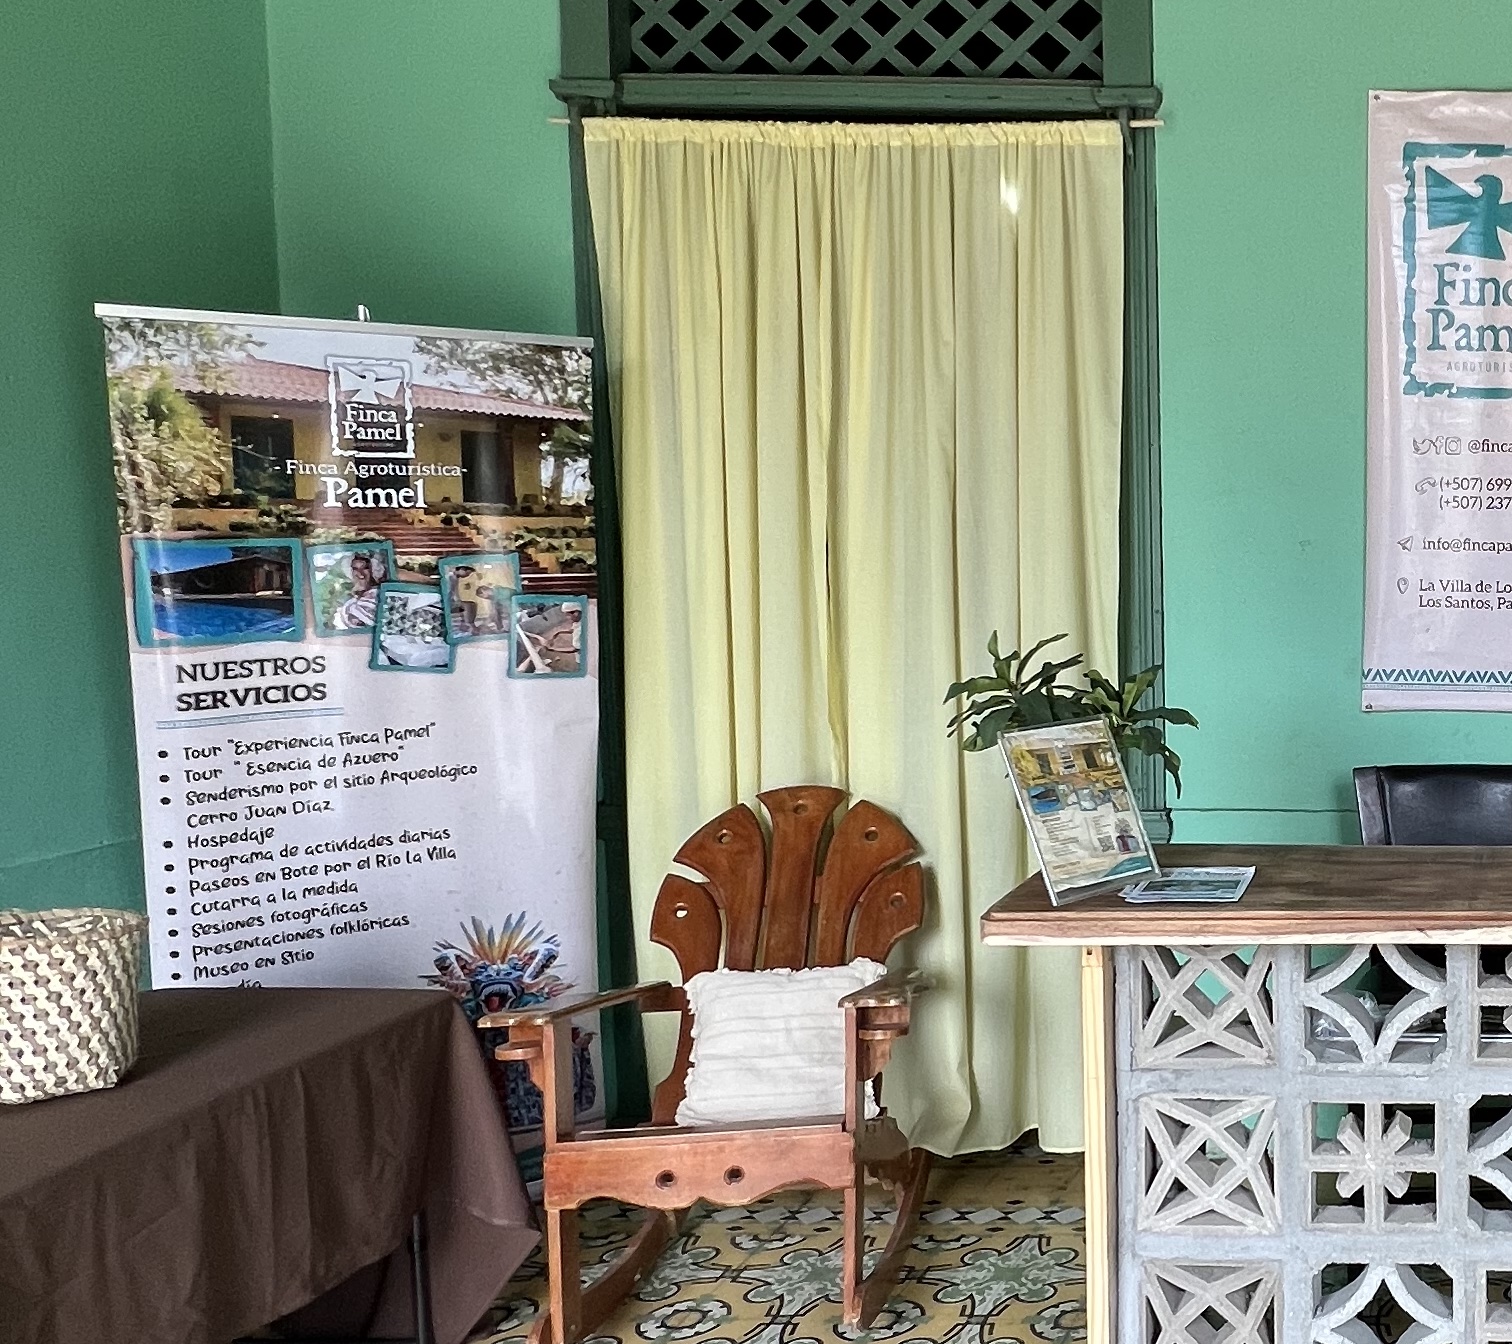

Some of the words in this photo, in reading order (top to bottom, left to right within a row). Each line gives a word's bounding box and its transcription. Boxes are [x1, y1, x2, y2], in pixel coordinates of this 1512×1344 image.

[346, 404, 398, 422] Finca
[342, 421, 403, 441] Pamel
[286, 460, 337, 475] Finca
[320, 477, 428, 508] Pamel
[1439, 477, 1483, 492] (+507)
[1439, 495, 1483, 511] (+507)
[1419, 578, 1436, 592] La
[1439, 579, 1472, 593] Villa
[1475, 580, 1492, 593] de
[1418, 595, 1442, 608] Los
[1444, 596, 1494, 612] Santos,
[176, 656, 326, 684] NUESTROS
[177, 683, 327, 712] SERVICIOS
[183, 745, 222, 760] Tour
[339, 731, 379, 745] Finca
[184, 768, 223, 784] Tour
[317, 753, 337, 768] de
[186, 783, 284, 805] Senderismo
[289, 780, 317, 795] por
[323, 777, 338, 789] el
[343, 774, 375, 788] sitio
[380, 763, 478, 785] Arqueológico
[187, 811, 238, 828] Cerro
[245, 805, 286, 820] Juan
[187, 826, 275, 848] Hospedaje
[189, 849, 274, 874] Programa
[280, 844, 299, 858] de
[305, 834, 393, 858] actividades
[399, 827, 451, 844] diarias
[190, 876, 249, 896] Paseos
[255, 871, 276, 882] en
[282, 864, 318, 881] Bote
[324, 861, 351, 875] por
[357, 857, 370, 870] el
[376, 853, 400, 867] Río
[406, 851, 422, 864] la
[427, 846, 456, 861] Villa
[191, 895, 260, 916] Cutarra
[266, 892, 276, 903] a
[282, 887, 297, 901] la
[302, 880, 358, 899] medida
[192, 916, 265, 938] Sesiones
[271, 900, 368, 924] fotográficas
[192, 927, 324, 961] Presentaciones
[330, 914, 410, 936] folklóricas
[194, 962, 249, 981] Museo
[254, 957, 276, 968] en
[281, 949, 315, 966] Sitio
